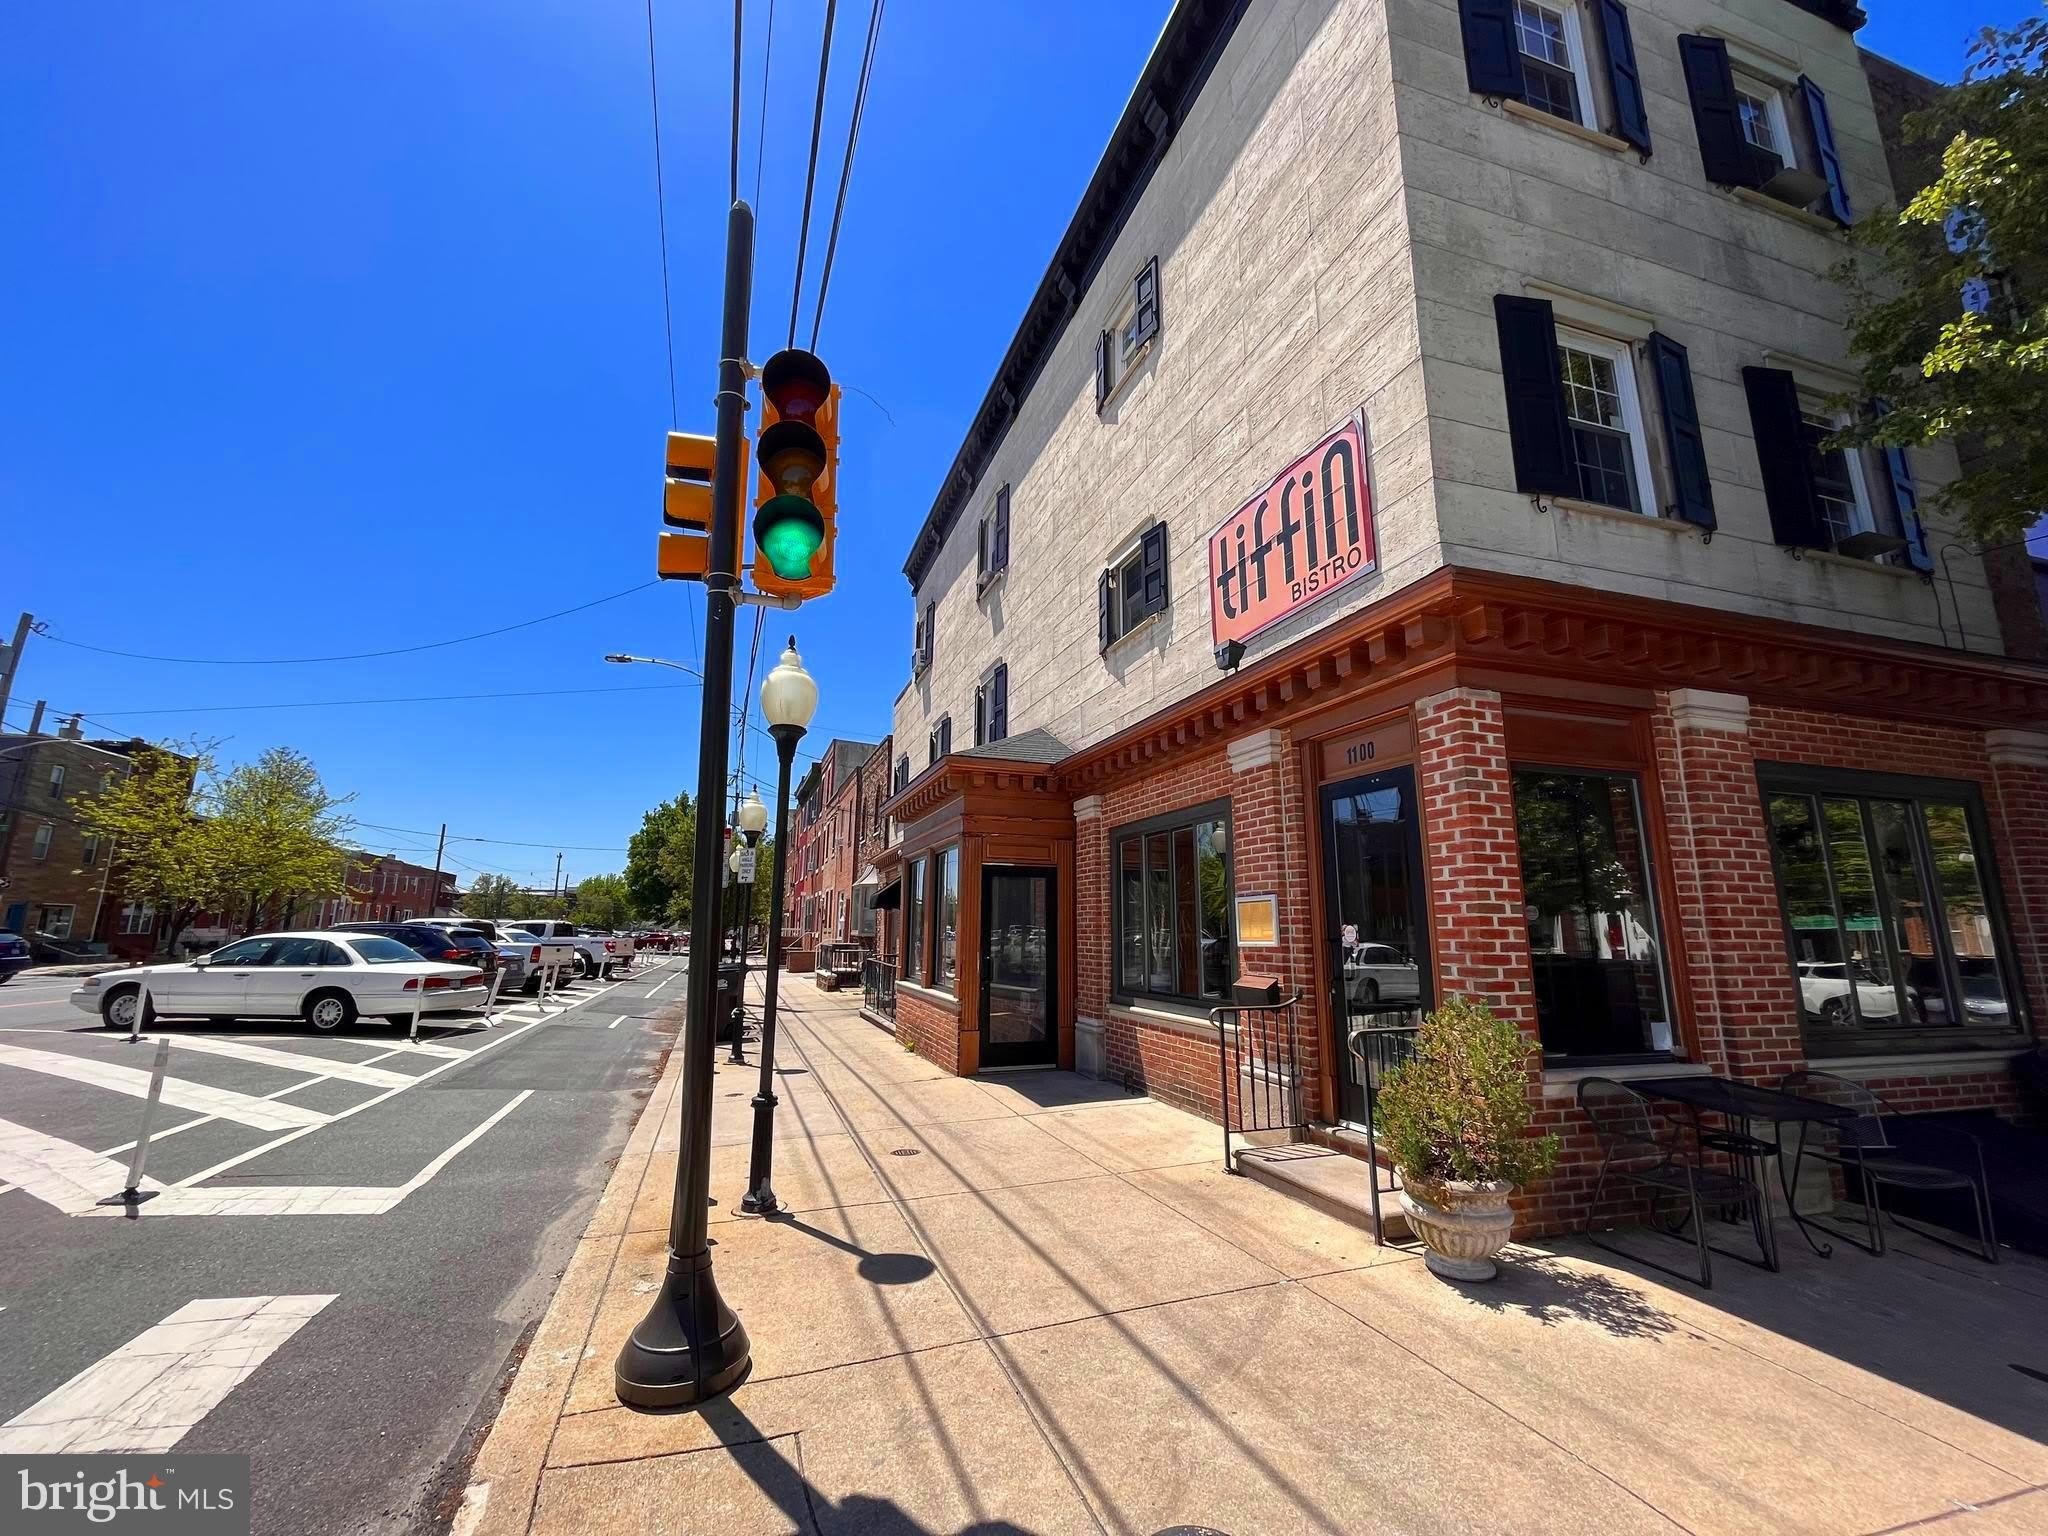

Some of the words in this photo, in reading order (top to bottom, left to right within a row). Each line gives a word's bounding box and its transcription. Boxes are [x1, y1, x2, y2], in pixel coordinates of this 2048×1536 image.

[1217, 438, 1360, 620] tiffin
[1291, 546, 1362, 603] BISTRO
[1346, 741, 1376, 765] 1100
